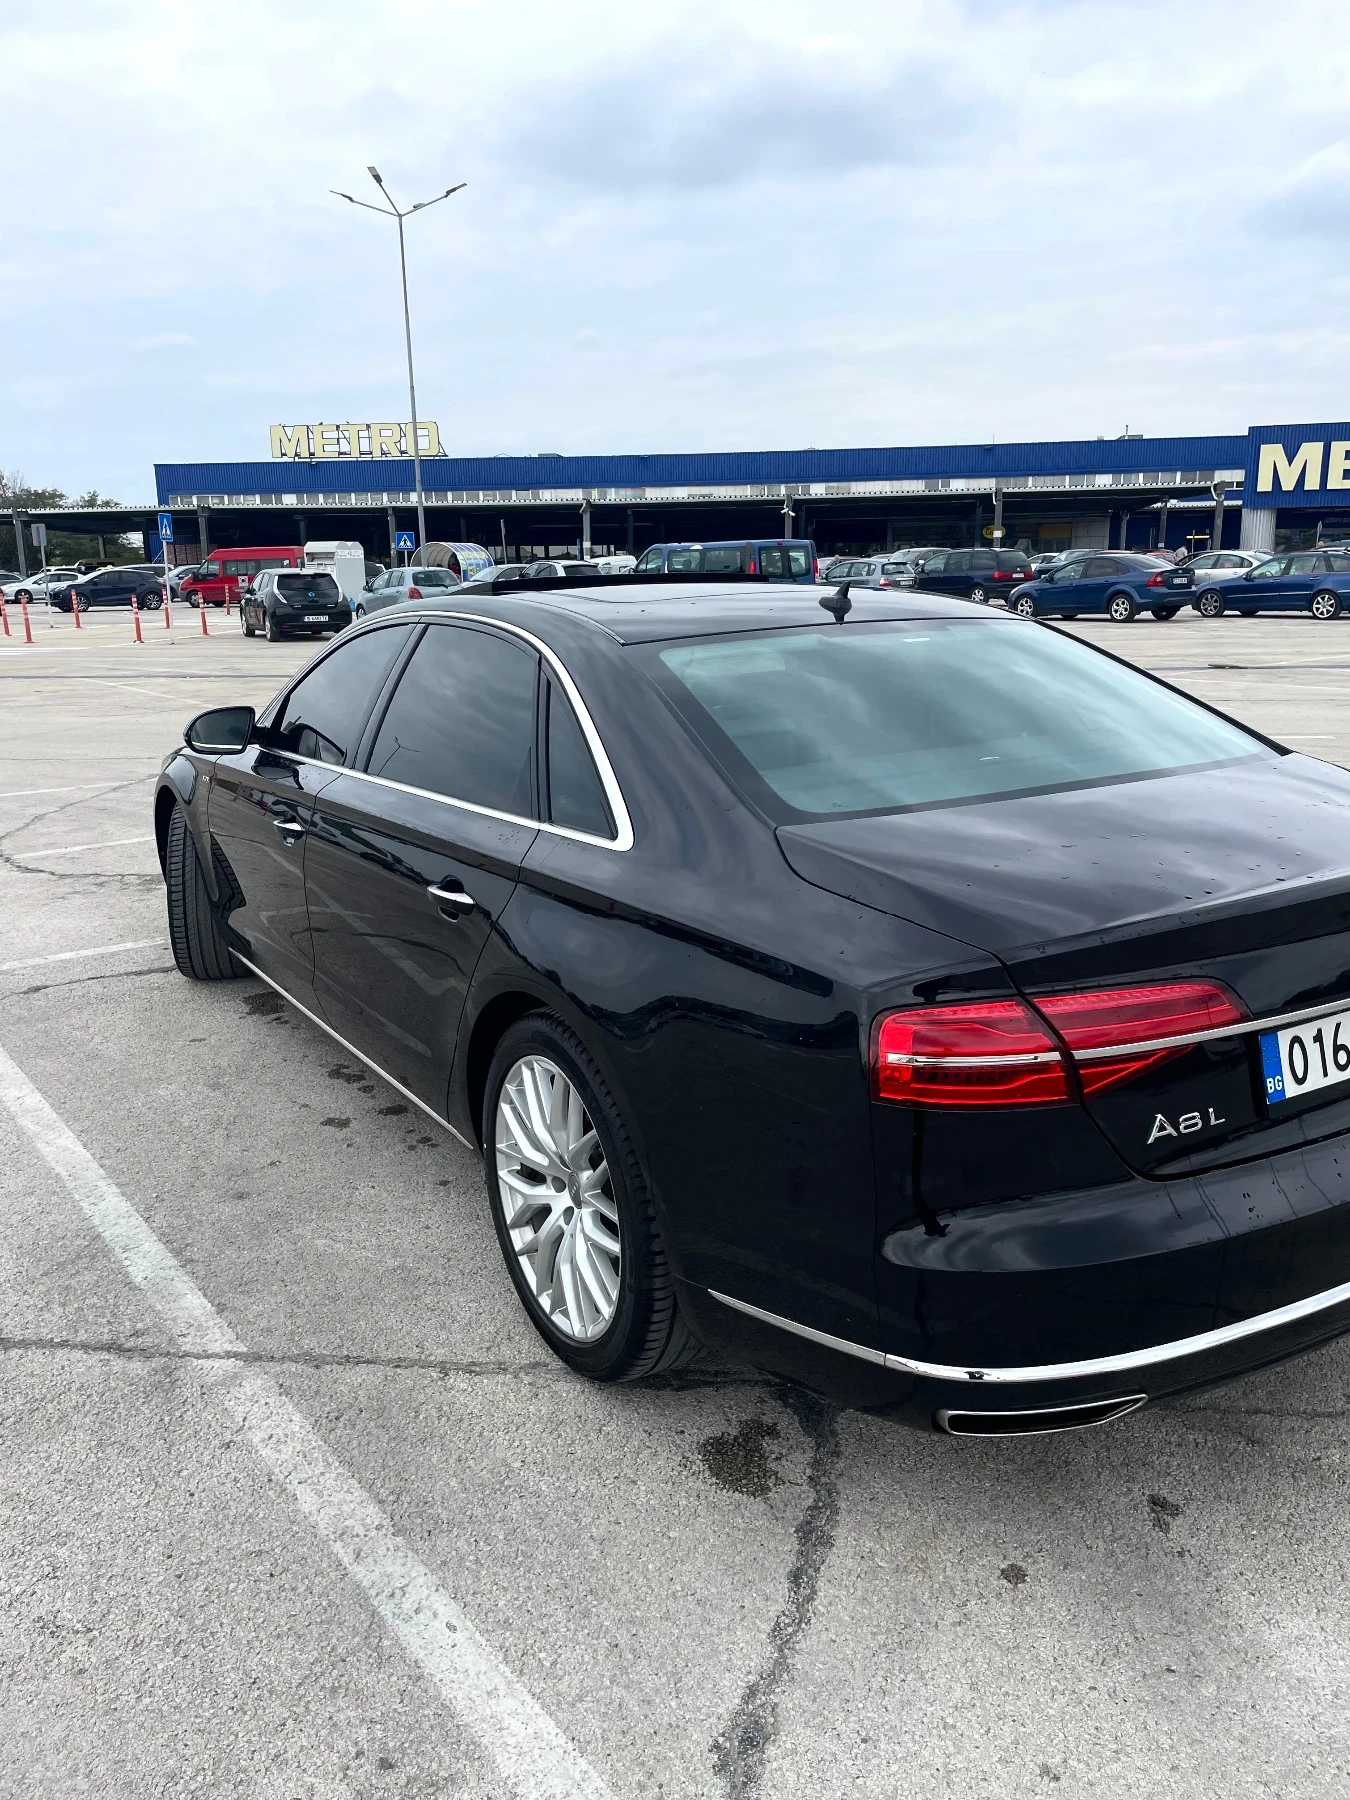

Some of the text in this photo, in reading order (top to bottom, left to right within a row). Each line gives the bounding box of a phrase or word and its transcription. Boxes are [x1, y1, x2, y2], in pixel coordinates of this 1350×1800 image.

[269, 421, 440, 458] METRO
[1266, 1022, 1350, 1094] BG 016
